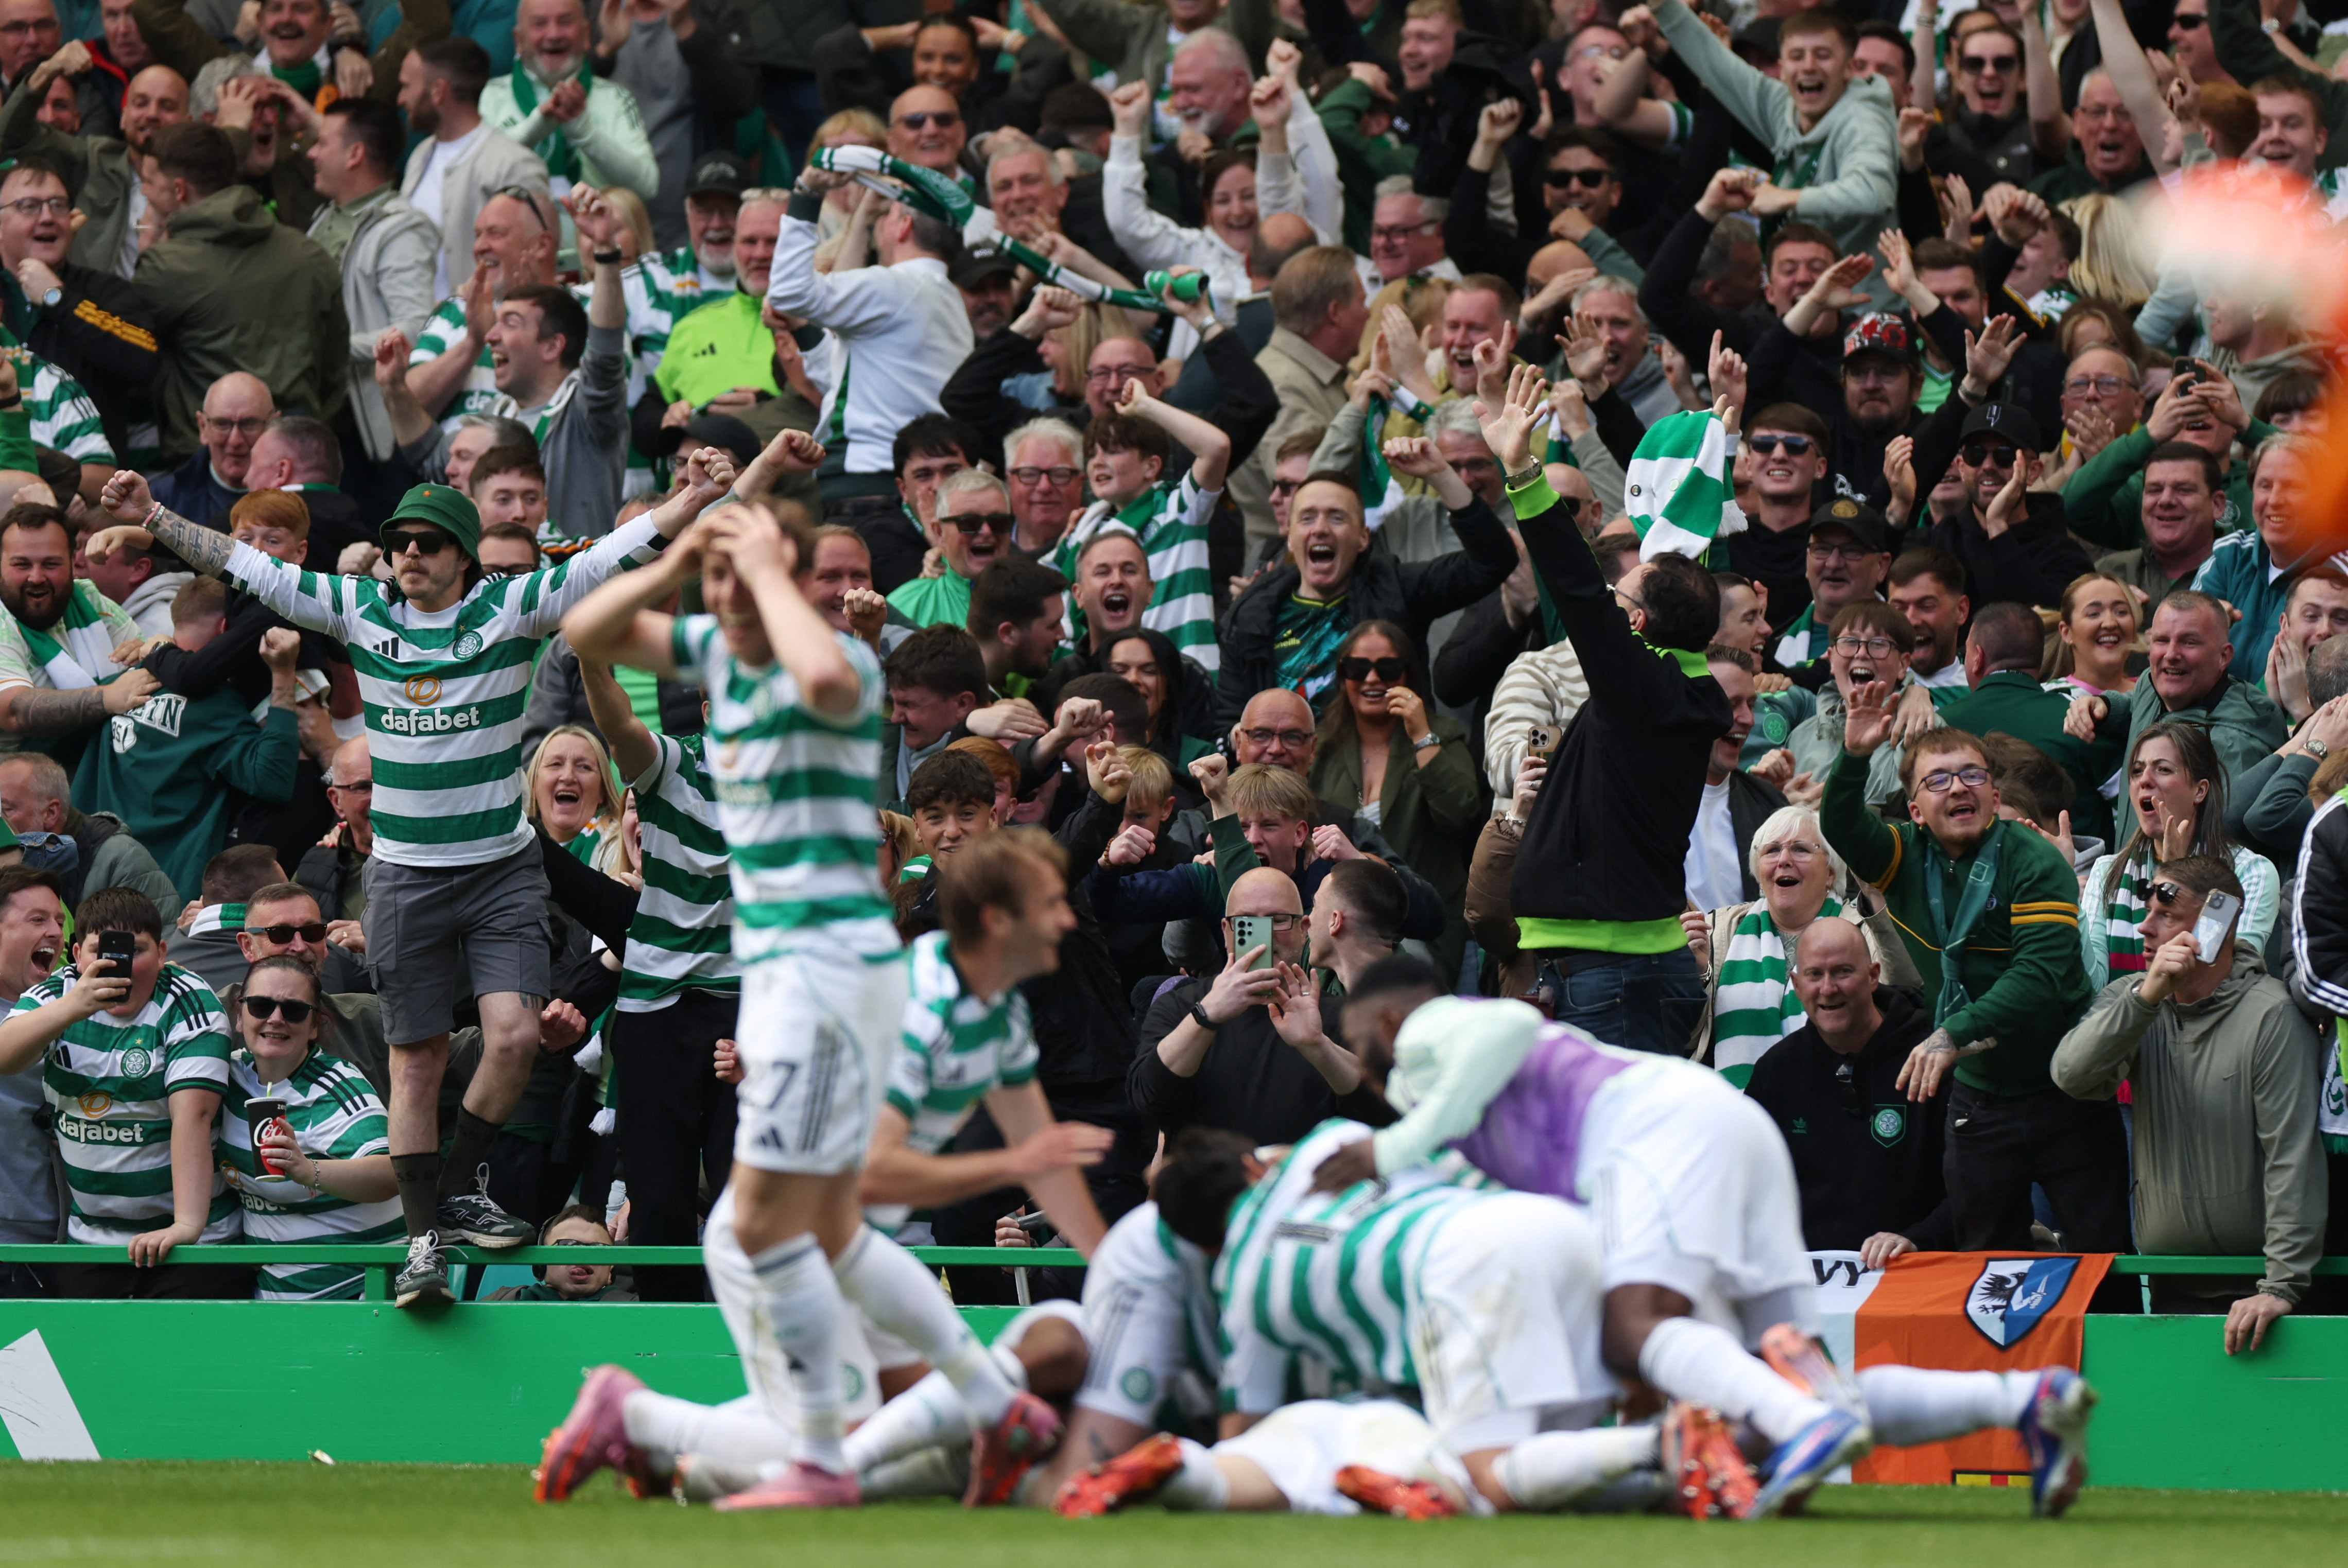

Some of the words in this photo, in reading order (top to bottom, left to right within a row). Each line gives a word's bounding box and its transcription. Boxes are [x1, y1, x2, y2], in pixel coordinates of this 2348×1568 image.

[381, 706, 480, 736] dafabet
[770, 1060, 799, 1110] 7
[58, 1112, 144, 1143] dafabet
